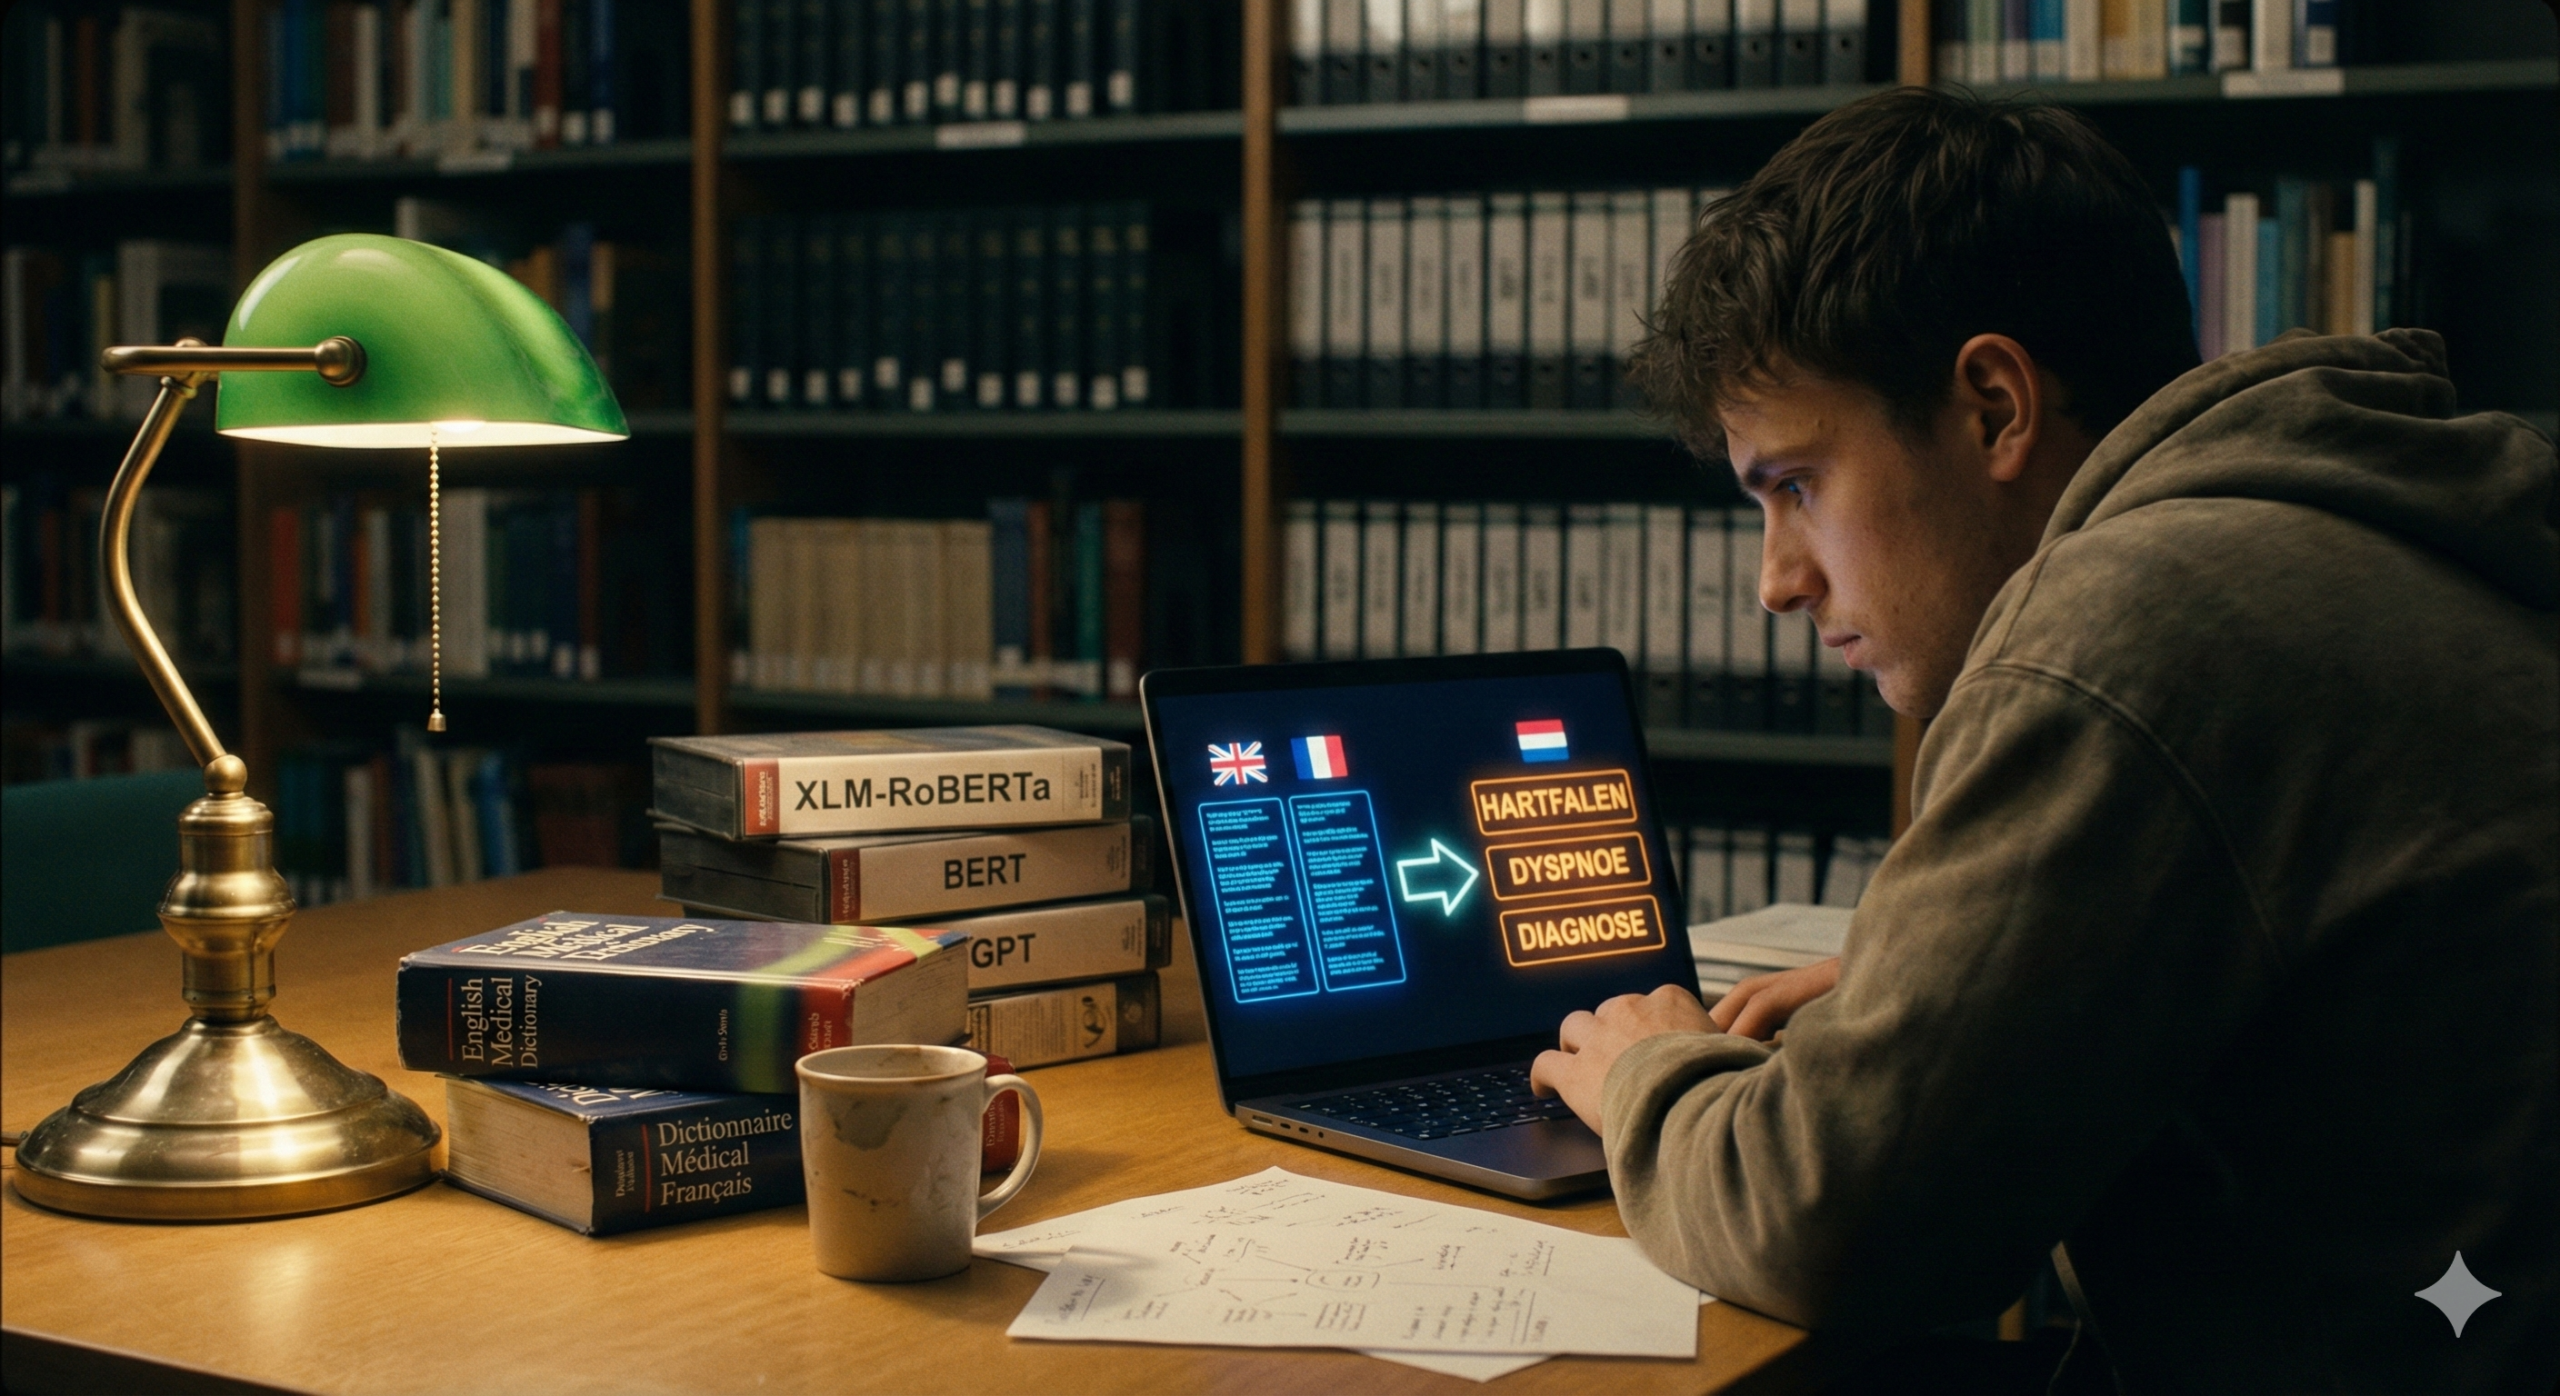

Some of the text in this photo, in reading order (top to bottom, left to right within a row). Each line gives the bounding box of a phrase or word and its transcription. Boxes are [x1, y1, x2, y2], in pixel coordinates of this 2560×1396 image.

[795, 771, 1051, 811] XLM-RoBERTa
[1479, 782, 1629, 823] HARTFALEN
[943, 853, 1027, 890] BERT
[1508, 847, 1630, 887] DYSPNOE
[1517, 909, 1648, 952] DIAGNOSE
[970, 933, 1037, 969] GPT
[461, 977, 490, 1062] English
[489, 977, 514, 1068] Medical
[519, 974, 543, 1069] Dictionary
[657, 1108, 794, 1147] Dictionnaire
[660, 1141, 751, 1177] Médical
[660, 1171, 752, 1207] Français
